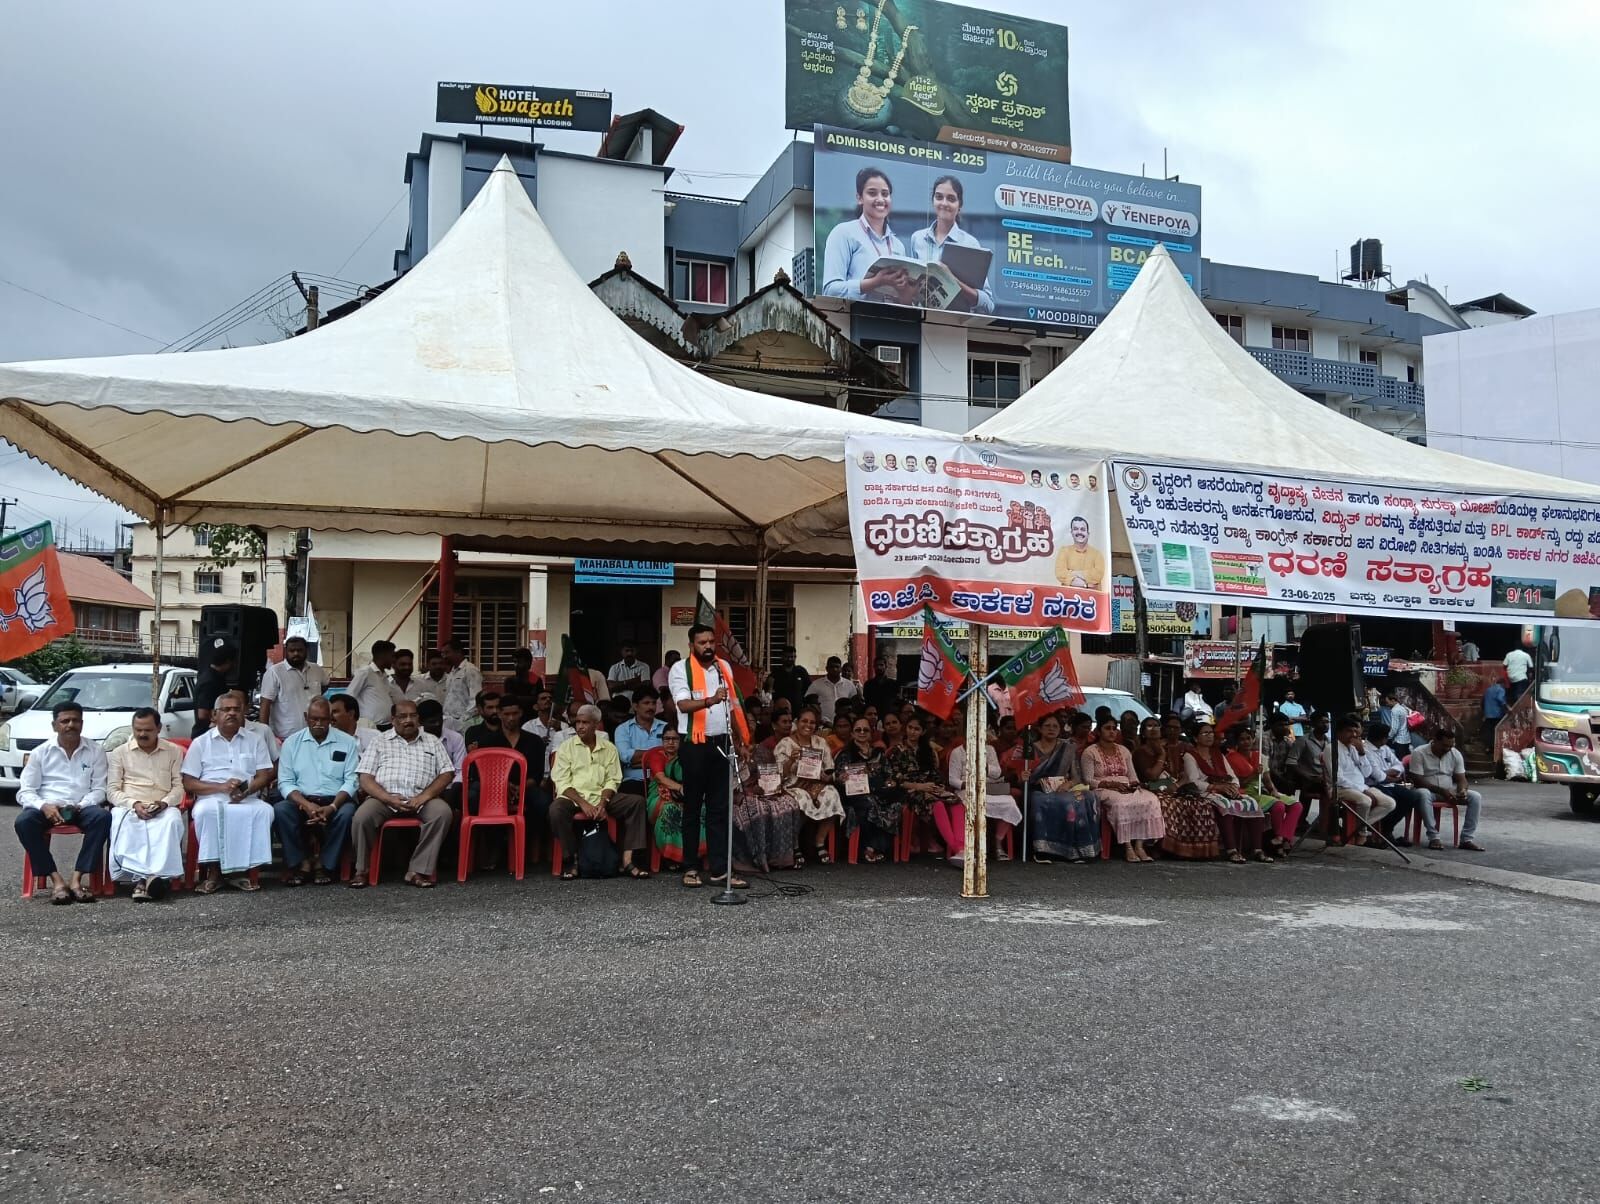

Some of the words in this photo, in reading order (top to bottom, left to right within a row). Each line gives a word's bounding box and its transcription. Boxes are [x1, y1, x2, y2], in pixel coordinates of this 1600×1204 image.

[476, 86, 574, 118] Swagath
[499, 89, 540, 101] HOTEL
[965, 93, 1000, 114] ಸ್ವರ್ಣ
[1001, 100, 1046, 119] ಪ್ರಕಾಶ್
[826, 133, 906, 155] ADMISSIONS
[909, 146, 943, 161] OPEN
[952, 152, 985, 167] 2025
[1005, 160, 1040, 180] Build
[1042, 166, 1062, 184] the
[1064, 172, 1101, 190] future
[1103, 182, 1123, 195] you
[1126, 180, 1163, 199] believe
[1019, 190, 1093, 212] YENEPOYA
[1021, 202, 1050, 211] INSTITUTE
[1056, 207, 1093, 217] TECHNOLOGY
[1123, 210, 1191, 231] YENEPOYA
[1007, 231, 1033, 250] BE
[921, 485, 934, 493] ಜನ
[1151, 472, 1192, 496] ವೃದ್ಧರಿಗೆ
[1197, 475, 1263, 502] ಆಸರೆಯಾಗಿದ್ದ
[1312, 485, 1343, 502] ವೇತನ
[1348, 491, 1380, 505] ಹಾಗೂ
[1130, 492, 1152, 514] ಪೈಕಿ
[1155, 497, 1228, 521] ಬಹುತೇಕರನ್ನು
[1322, 509, 1360, 533] ವಿದ್ಯುತ್
[1464, 521, 1487, 540] ಮತ್ತು
[1491, 523, 1512, 538] BPL
[1565, 528, 1584, 550] ರದ್ದು
[868, 512, 942, 551] ಧರಣಿ
[945, 521, 1050, 560] ಸತ್ಯಾಗ್ರಹ
[1126, 515, 1166, 537] ಹುನ್ನಾರ
[1170, 520, 1219, 544] ನಡೆಸುತ್ತಿದ್ದ
[1224, 526, 1252, 548] ರಾಜ್ಯ
[1303, 531, 1352, 548] ಸರ್ಕಾರದ
[1357, 536, 1375, 550] ಜನ
[1379, 537, 1417, 555] ವಿರೋಧಿ
[1420, 540, 1469, 562] ನೀತಿಗಳನ್ನು
[1473, 545, 1503, 559] ಖಂಡಿಸಿ
[1507, 548, 1542, 562] ಕಾರ್ಕಳ
[1545, 550, 1570, 564] ನಗರ
[580, 559, 634, 569] MAHABALA
[637, 560, 670, 570] CLINIC
[1267, 549, 1348, 579] ಧರಣಿ
[1366, 554, 1492, 595] ಸತ್ಯಾಗ್ರಹ
[950, 587, 1034, 615] ಕಾರ್ಕಳ
[1042, 591, 1098, 620] ನಗರ
[1281, 588, 1336, 602] 23-06-2025
[1428, 596, 1476, 607] ಕಾರ್ಕಳ
[1362, 665, 1385, 674] STALL
